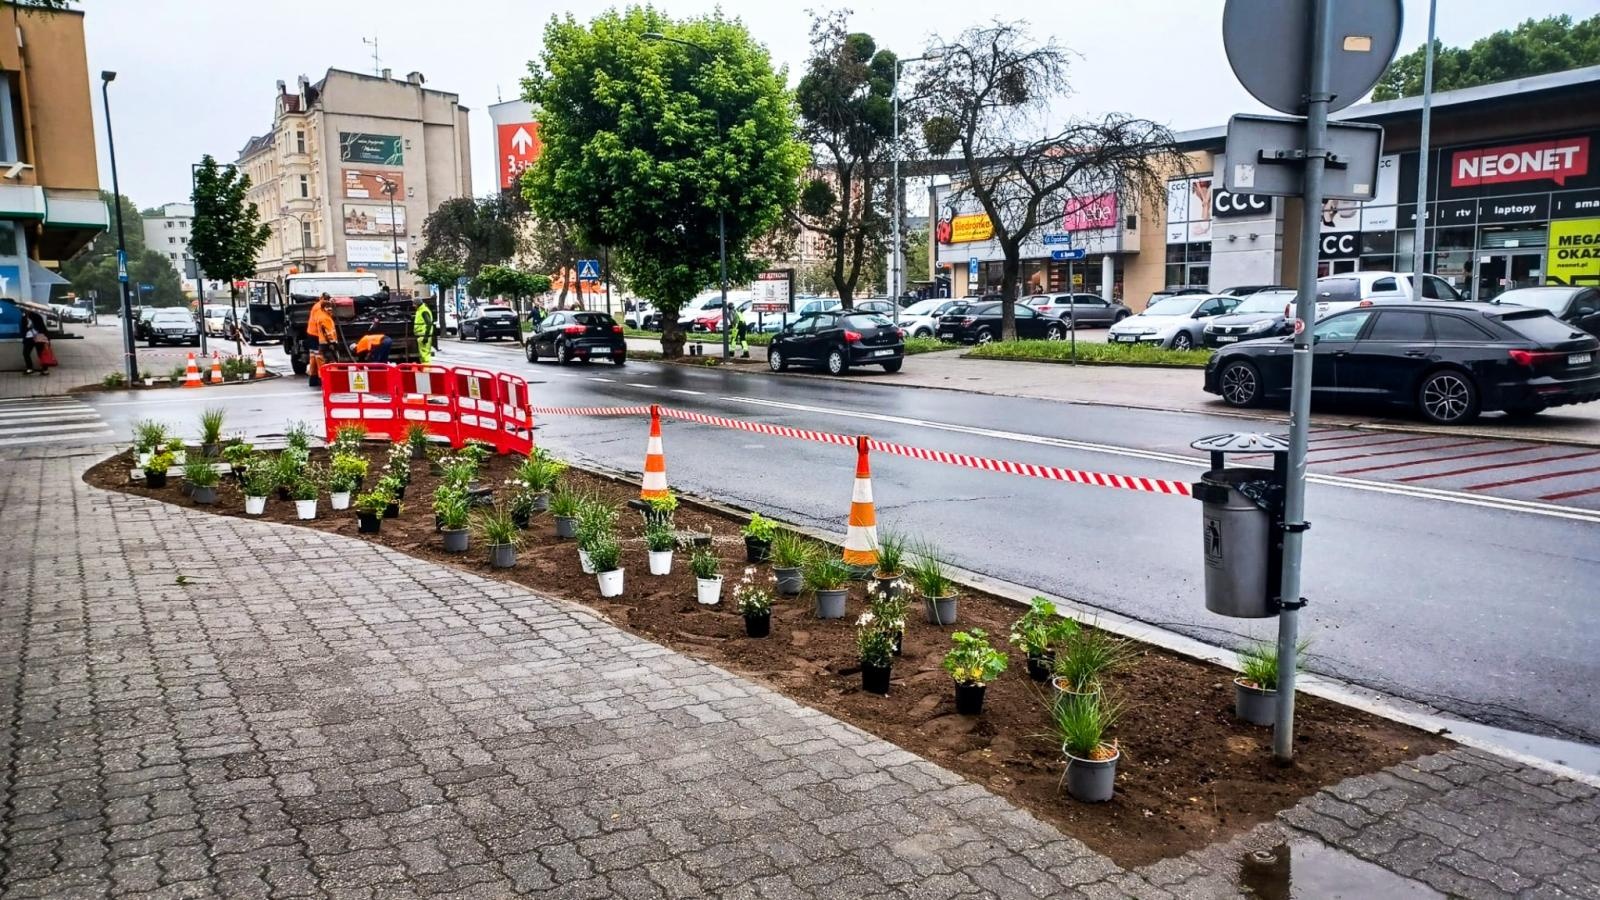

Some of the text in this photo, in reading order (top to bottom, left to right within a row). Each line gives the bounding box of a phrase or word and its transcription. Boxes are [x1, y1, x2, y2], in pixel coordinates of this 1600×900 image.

[1458, 146, 1580, 179] NEONET
[1171, 182, 1186, 191] CCC
[1215, 191, 1265, 212] CCC
[1410, 210, 1430, 220] ad
[1455, 208, 1472, 217] rtv
[1494, 204, 1537, 216] laptopy
[1318, 234, 1354, 254] CC
